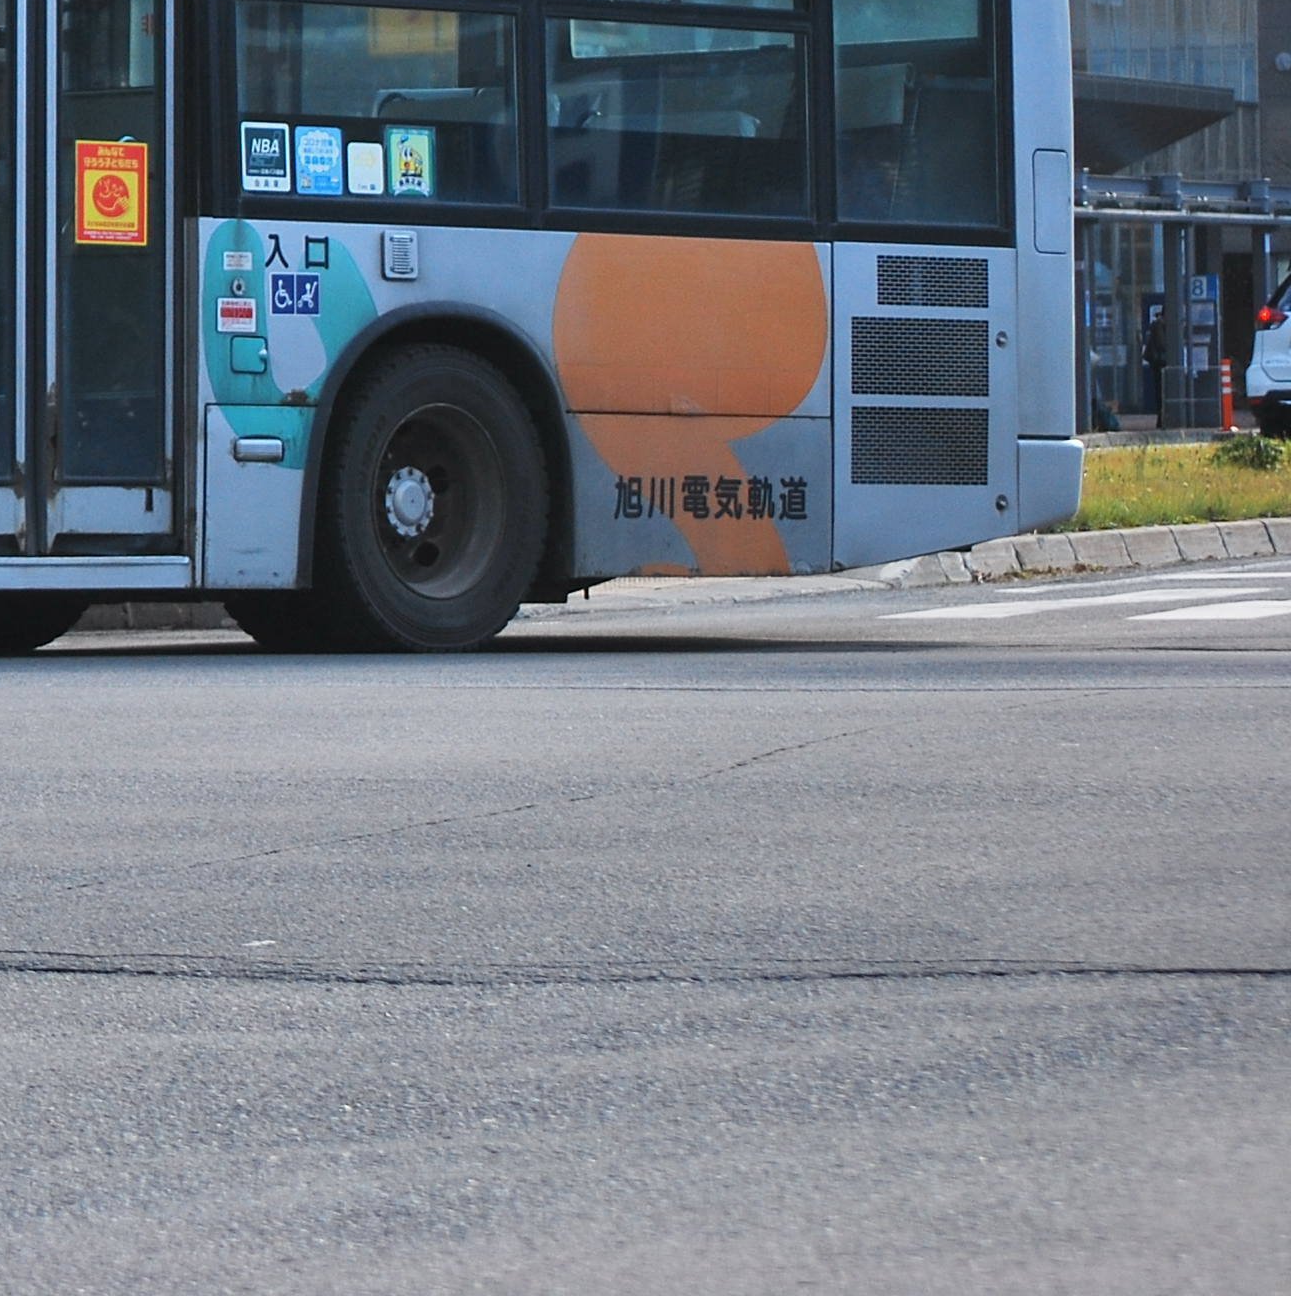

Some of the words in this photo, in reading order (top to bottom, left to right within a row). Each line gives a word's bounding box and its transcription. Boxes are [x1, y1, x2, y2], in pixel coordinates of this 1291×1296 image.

[97, 146, 125, 157] みんなで
[251, 138, 280, 154] NBA
[264, 233, 330, 270] 入口
[1191, 279, 1205, 297] 8
[614, 474, 808, 521] 旭川電気軌道
